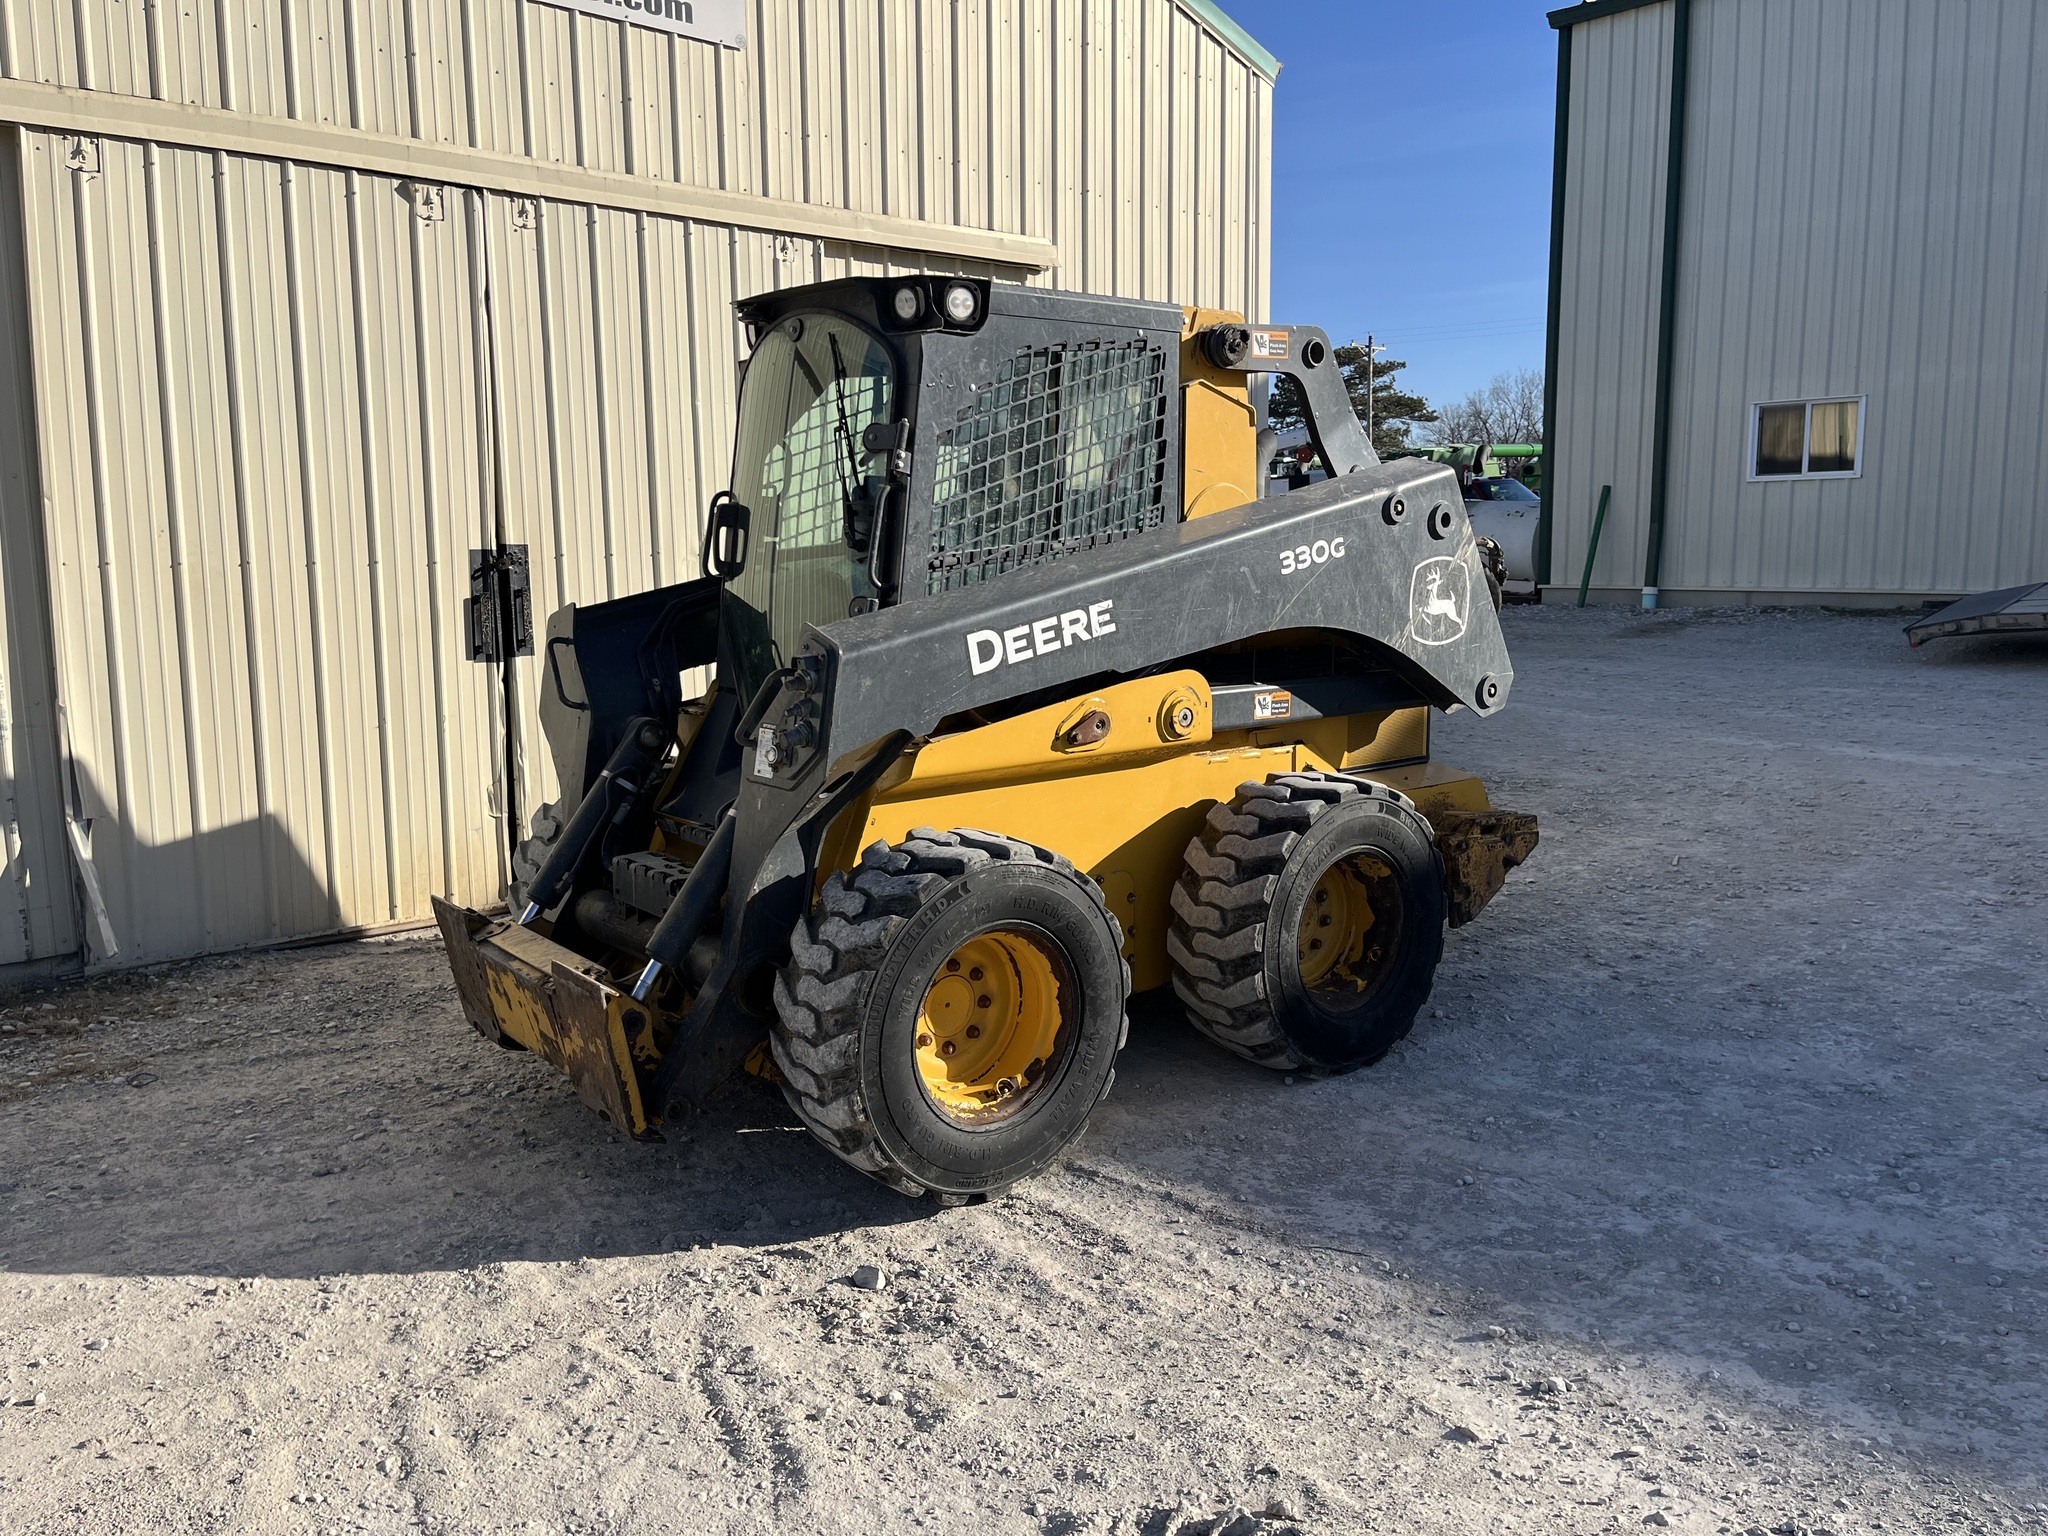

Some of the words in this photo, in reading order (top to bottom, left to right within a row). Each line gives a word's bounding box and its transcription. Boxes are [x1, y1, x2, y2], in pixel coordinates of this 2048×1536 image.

[1280, 537, 1345, 574] 330G
[967, 600, 1116, 675] DEERE
[1399, 813, 1417, 832] BKT
[883, 926, 922, 990] POWER
[920, 896, 953, 926] H.D.
